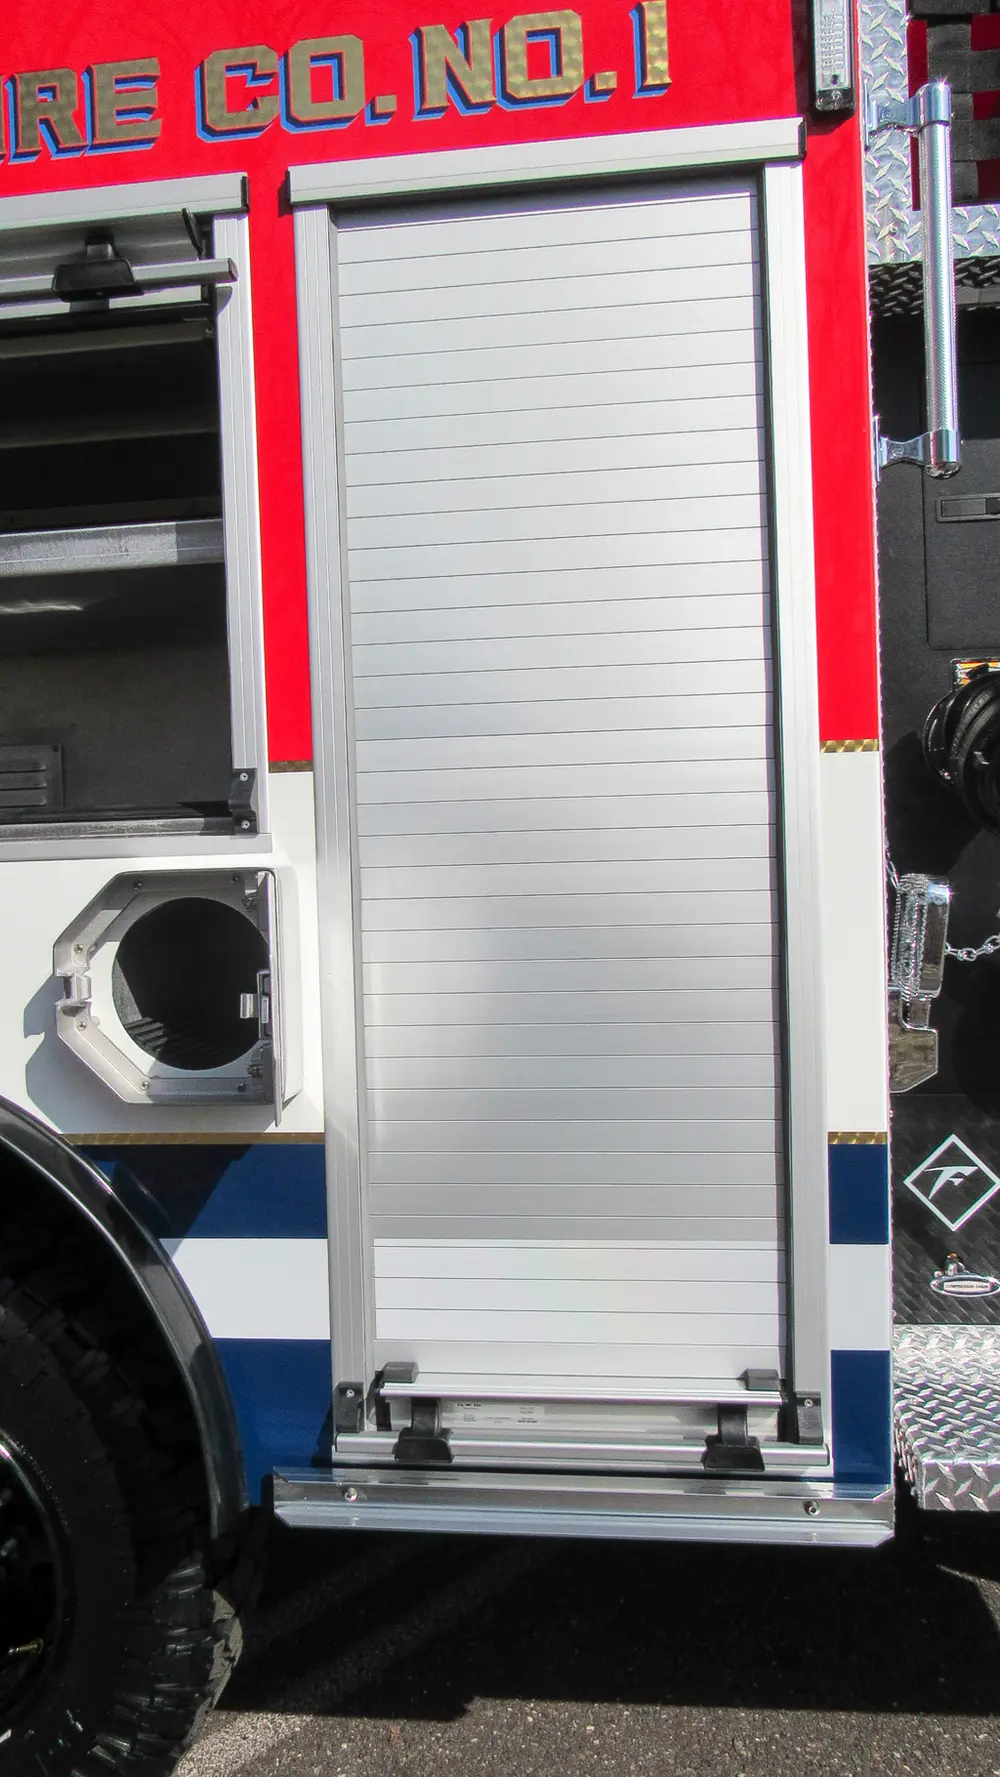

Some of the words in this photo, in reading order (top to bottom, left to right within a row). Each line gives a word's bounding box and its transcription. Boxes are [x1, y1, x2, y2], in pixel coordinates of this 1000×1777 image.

[0, 58, 162, 165] RE
[195, 34, 397, 143] CO.
[409, 9, 618, 121] NO.
